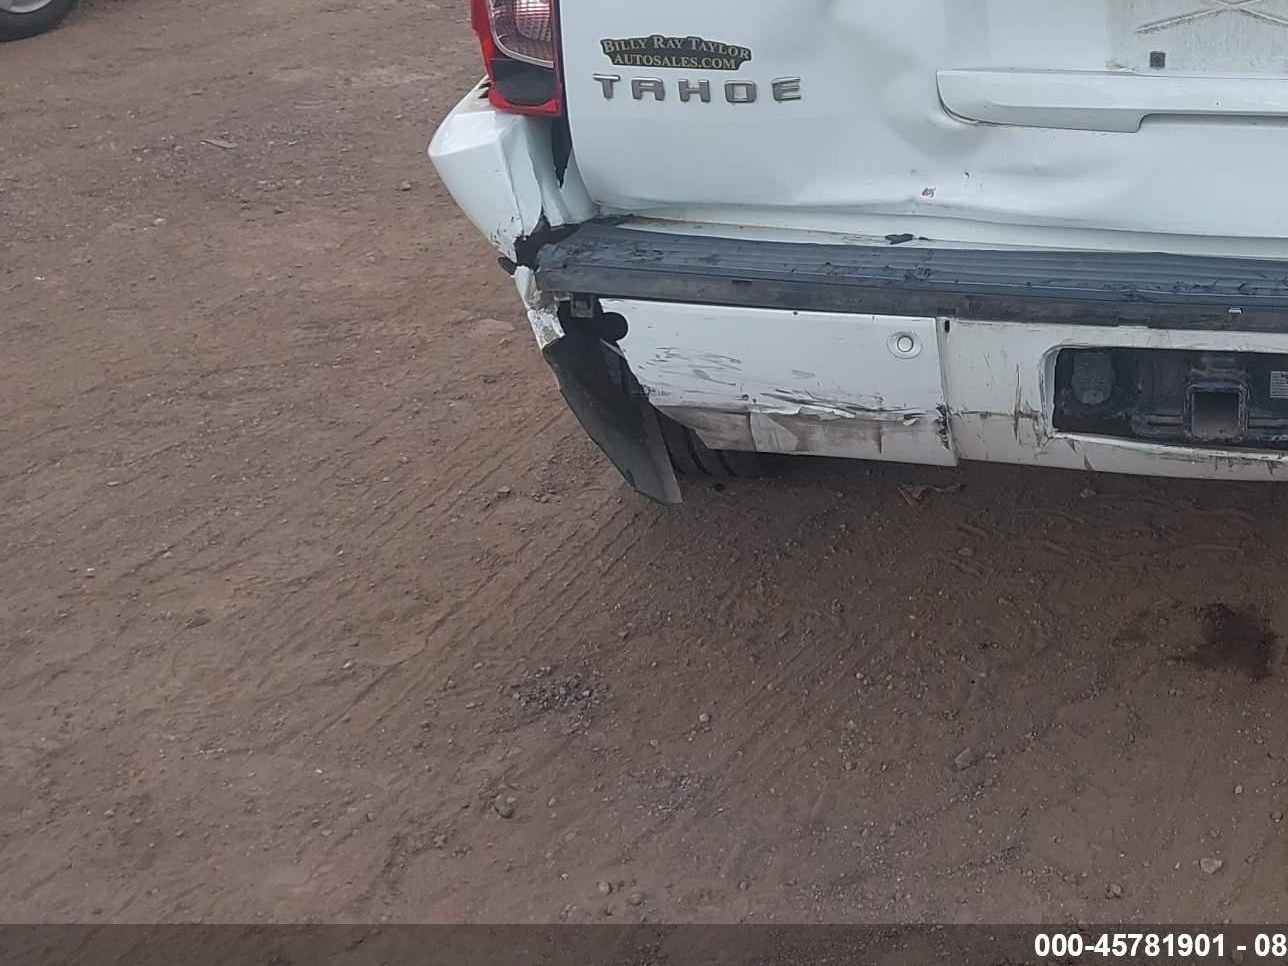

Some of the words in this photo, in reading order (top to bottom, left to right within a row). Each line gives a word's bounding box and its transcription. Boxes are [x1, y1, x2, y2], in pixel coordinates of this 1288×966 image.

[602, 38, 648, 54] BILLY
[652, 36, 684, 49] RAY
[688, 37, 750, 59] TAYLOR
[613, 53, 737, 69] AUTOSALES.COM
[592, 73, 801, 103] TAHOE
